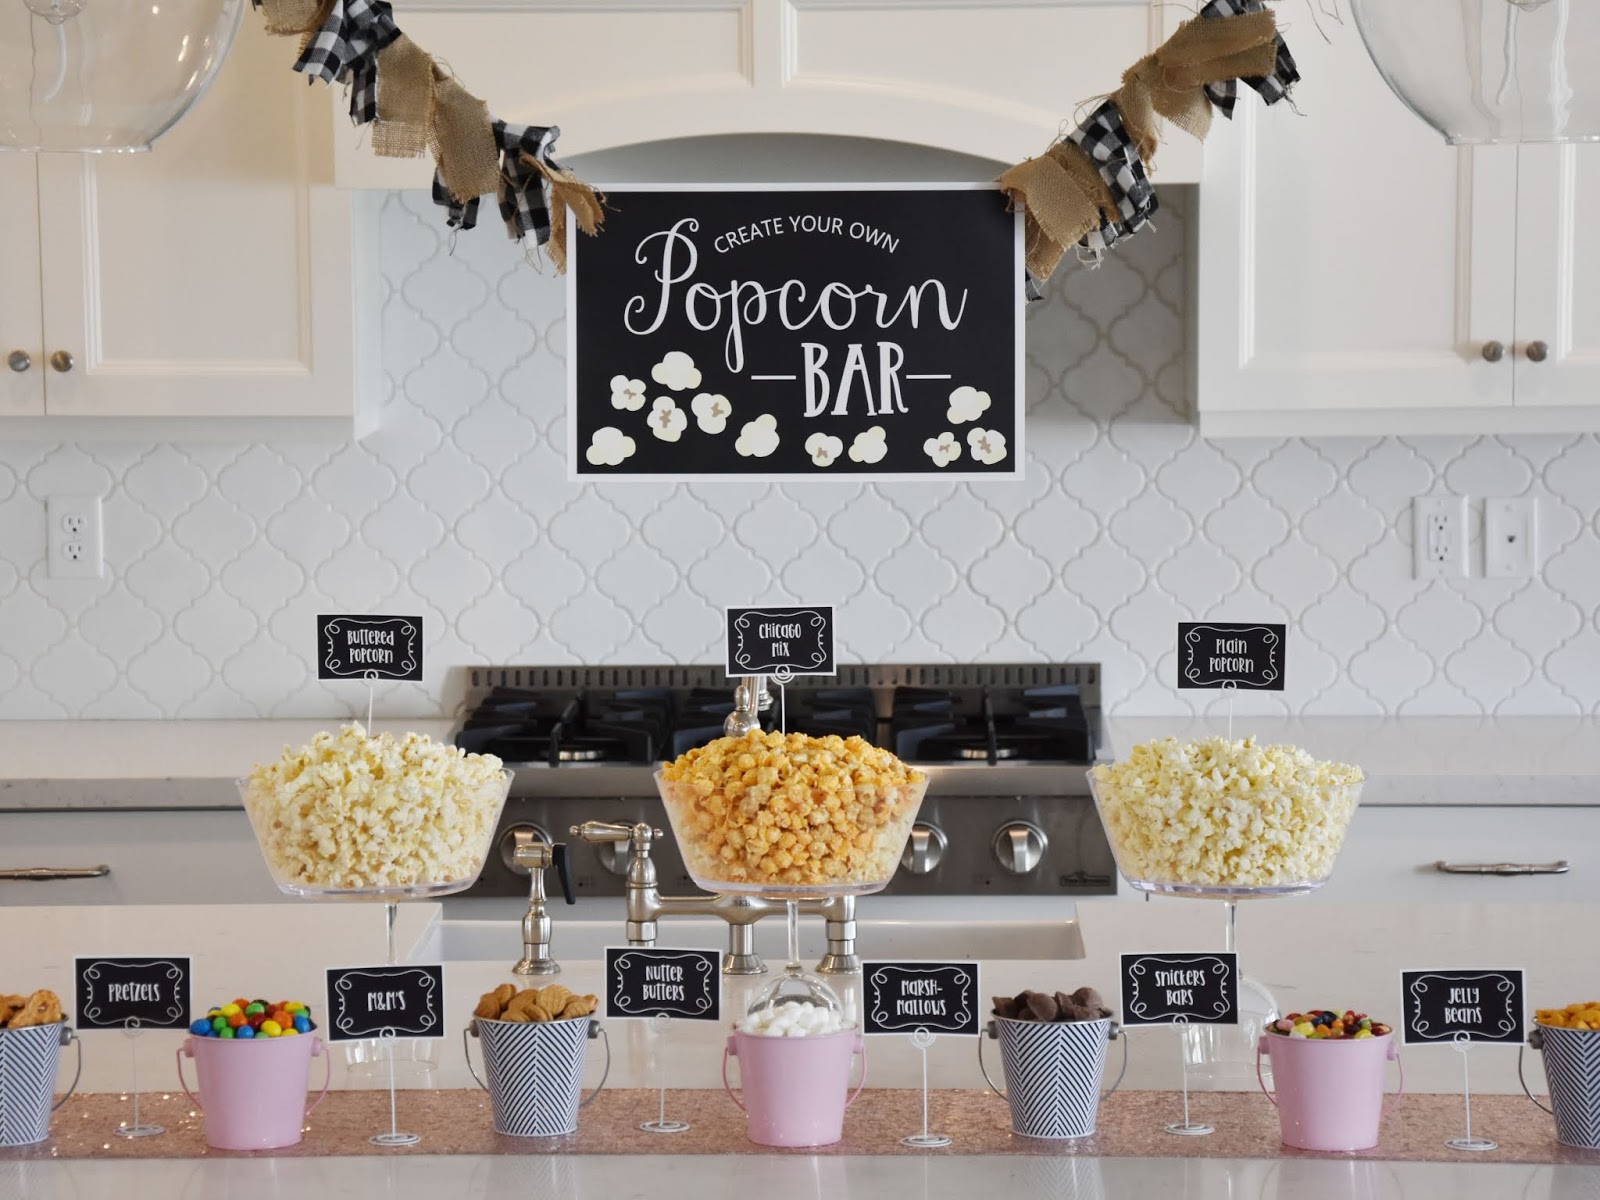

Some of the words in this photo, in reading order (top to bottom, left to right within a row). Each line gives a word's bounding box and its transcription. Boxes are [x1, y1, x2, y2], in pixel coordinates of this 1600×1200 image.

[713, 218, 784, 254] CREATE
[788, 215, 843, 235] YOUR
[848, 221, 900, 254] OWN
[623, 217, 968, 374] Popcorn
[800, 341, 909, 418] BAR
[367, 990, 406, 1012] M&M'S
